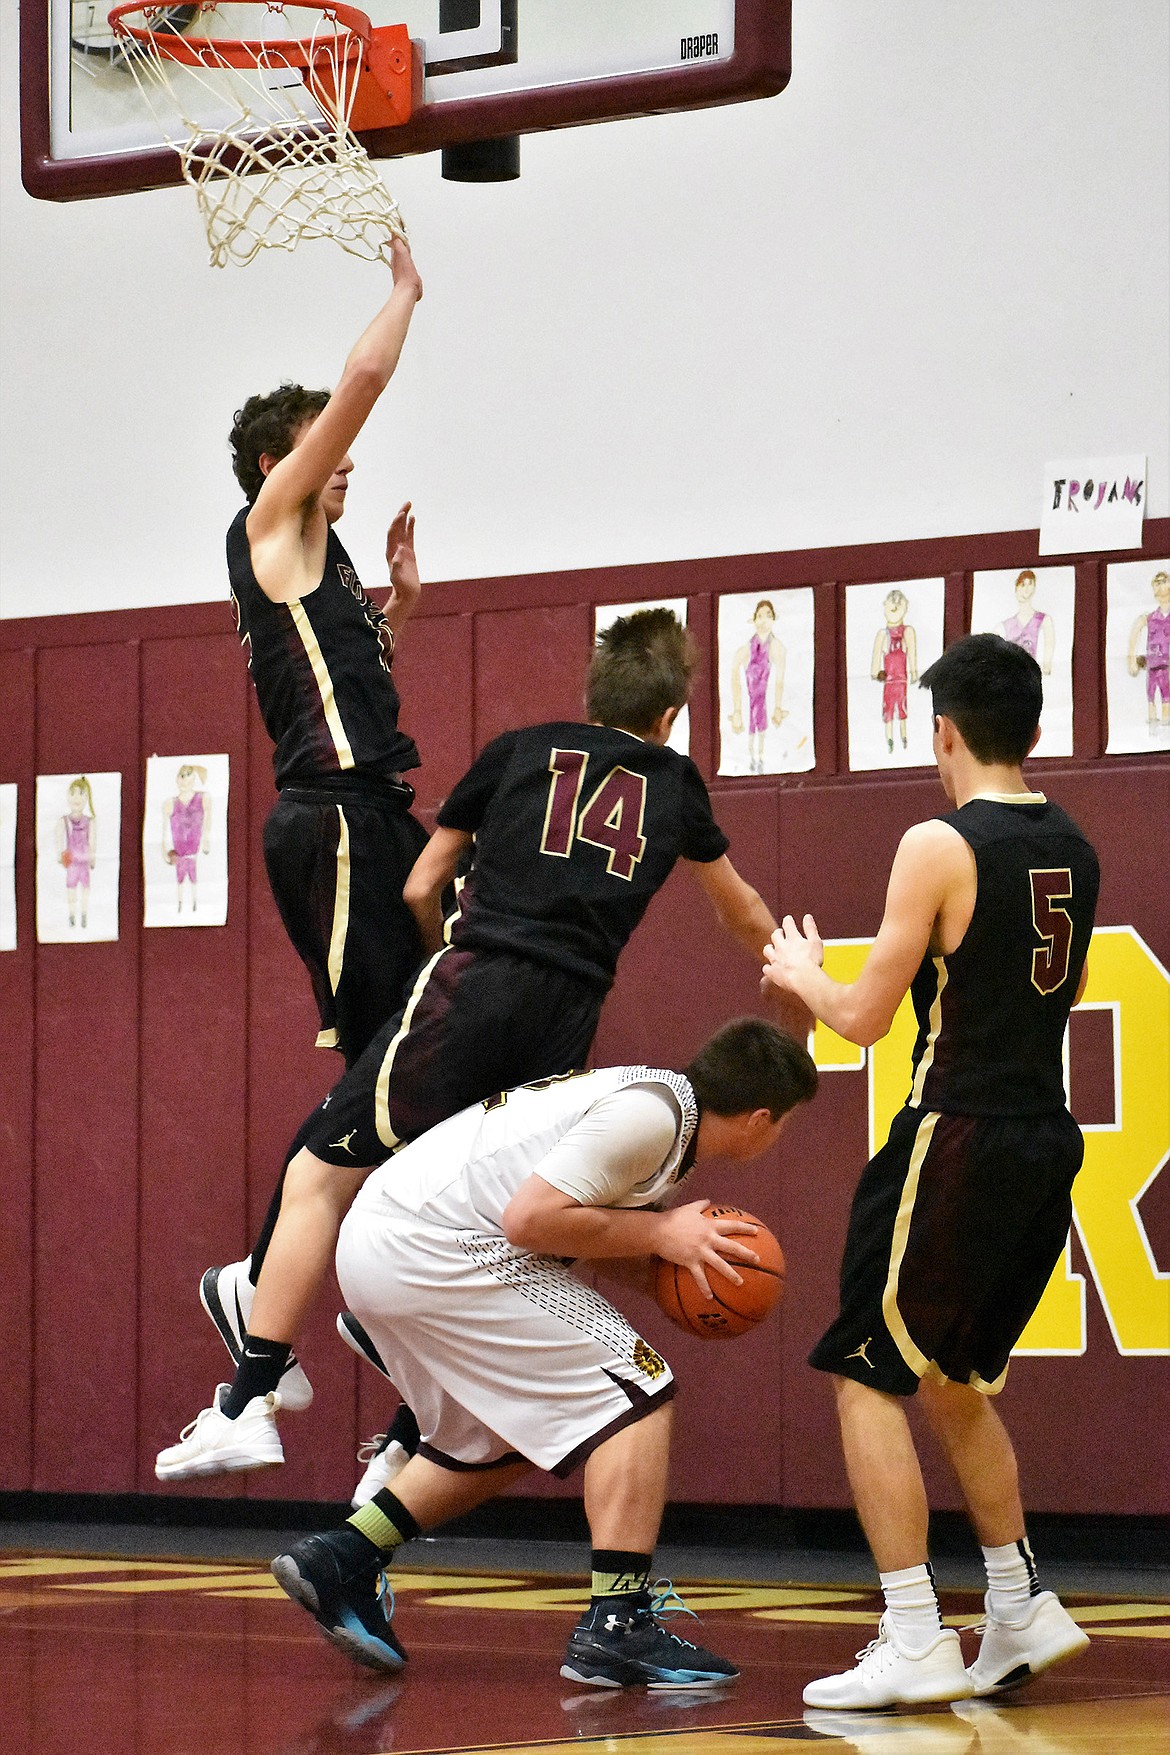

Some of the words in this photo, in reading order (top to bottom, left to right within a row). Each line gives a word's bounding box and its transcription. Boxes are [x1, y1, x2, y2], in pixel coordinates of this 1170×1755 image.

[680, 33, 718, 60] DRAPER
[1052, 475, 1144, 513] TROJANS
[539, 747, 648, 881] 14
[1028, 868, 1073, 996] 5
